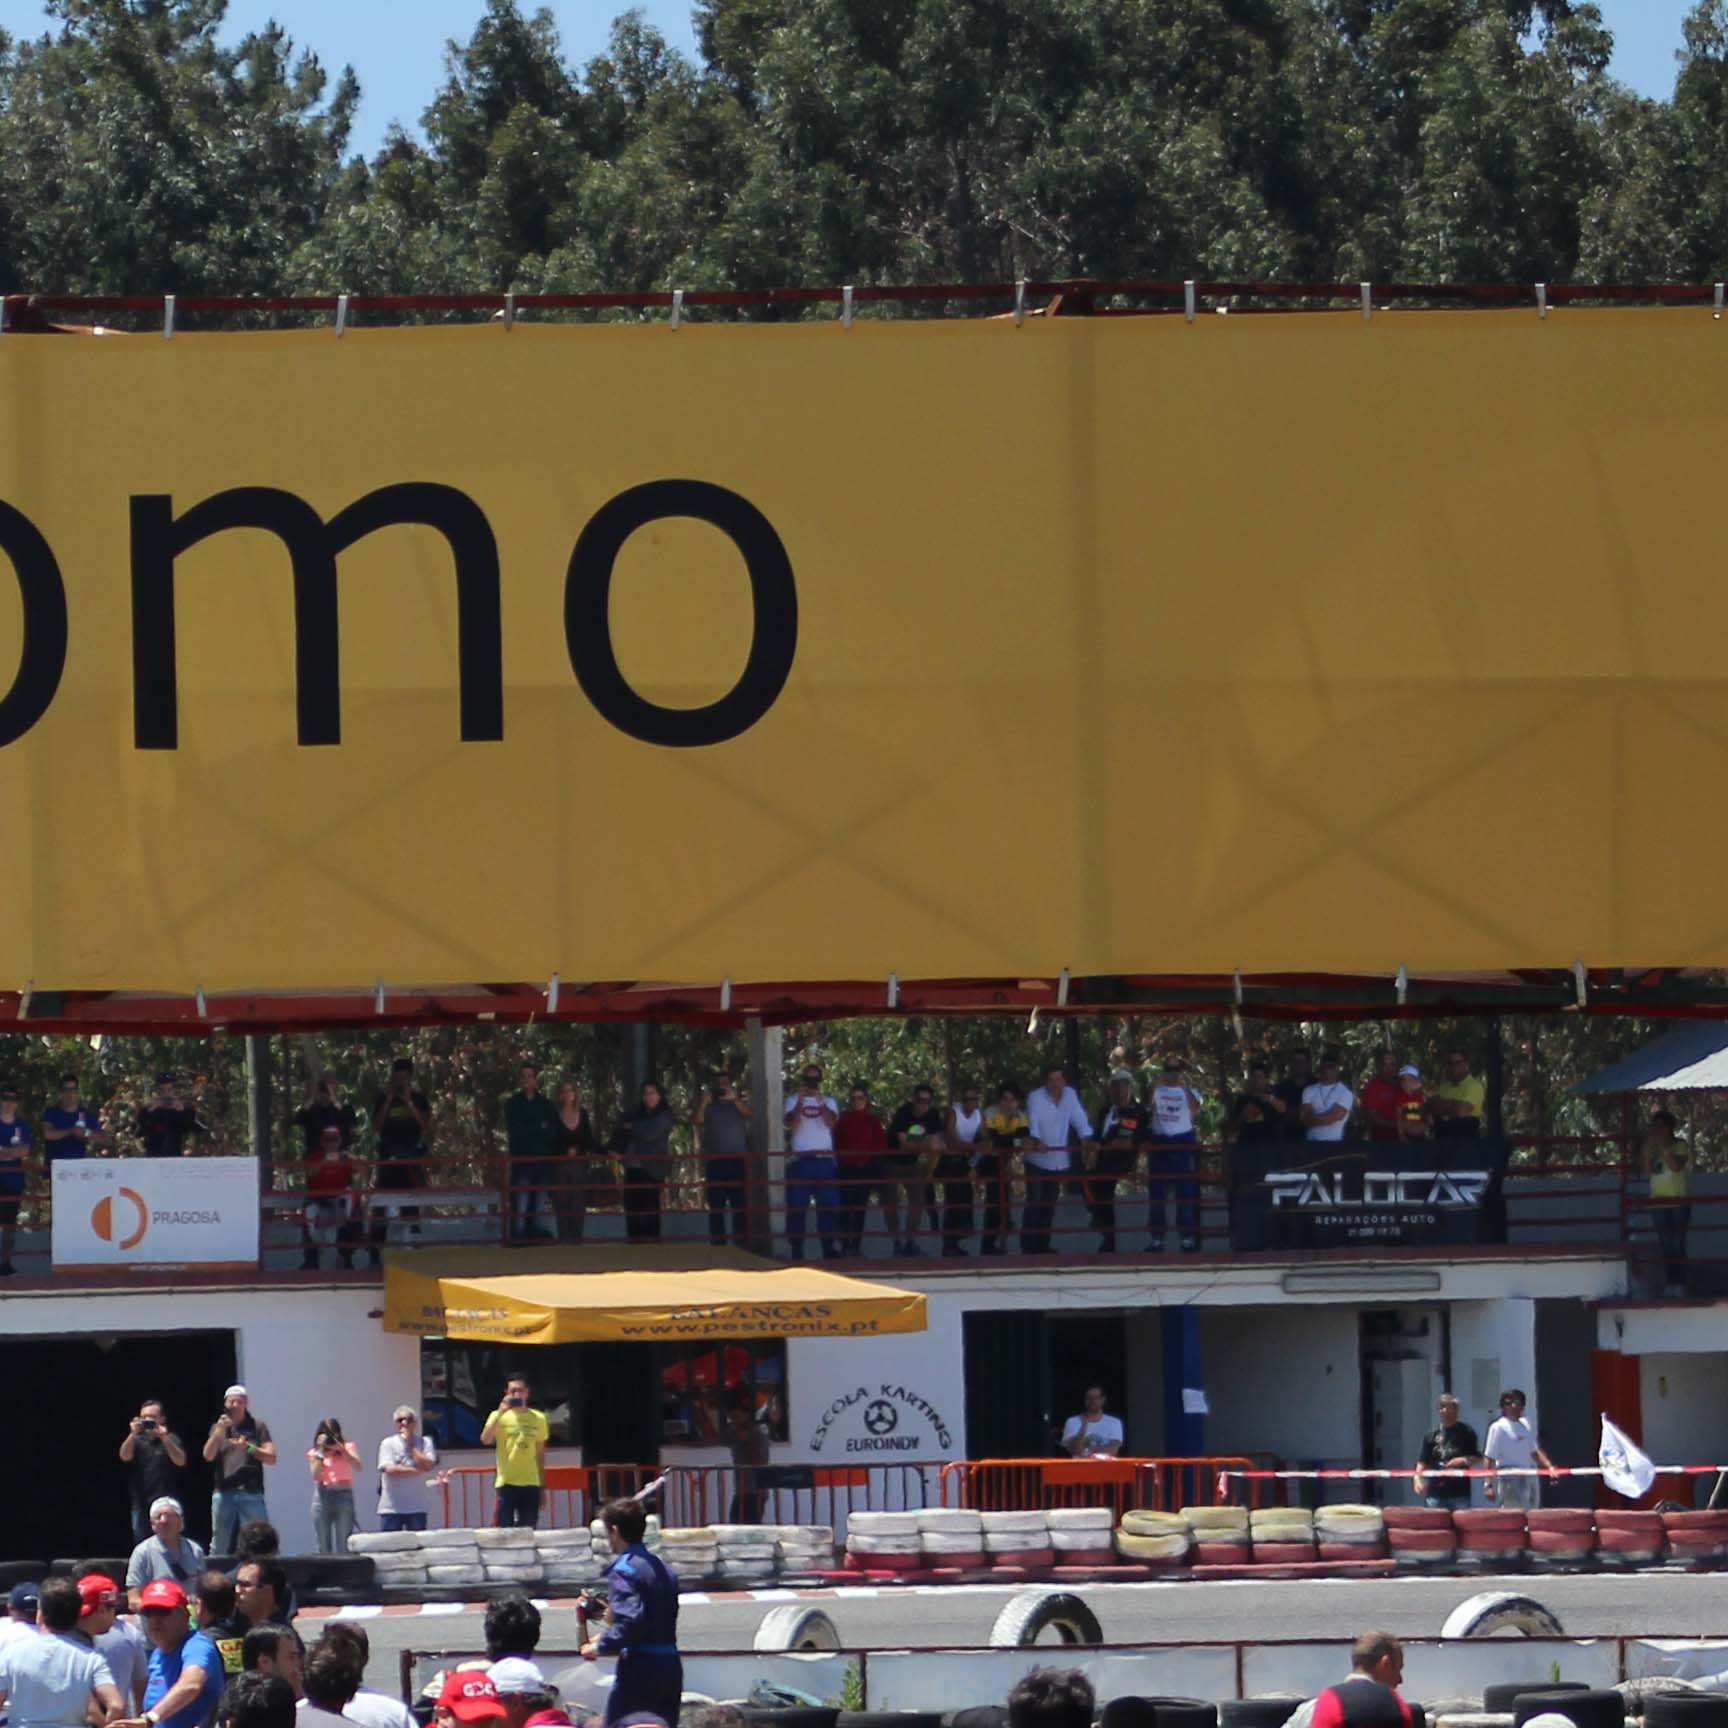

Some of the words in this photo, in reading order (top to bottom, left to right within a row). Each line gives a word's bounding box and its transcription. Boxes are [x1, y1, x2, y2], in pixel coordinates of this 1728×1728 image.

[1402, 1215, 1436, 1225] AUTO
[809, 1387, 869, 1452] ESCOLA
[880, 1384, 953, 1450] KARTING
[845, 1436, 920, 1452] EUROINDY
[221, 1640, 245, 1653] GA
